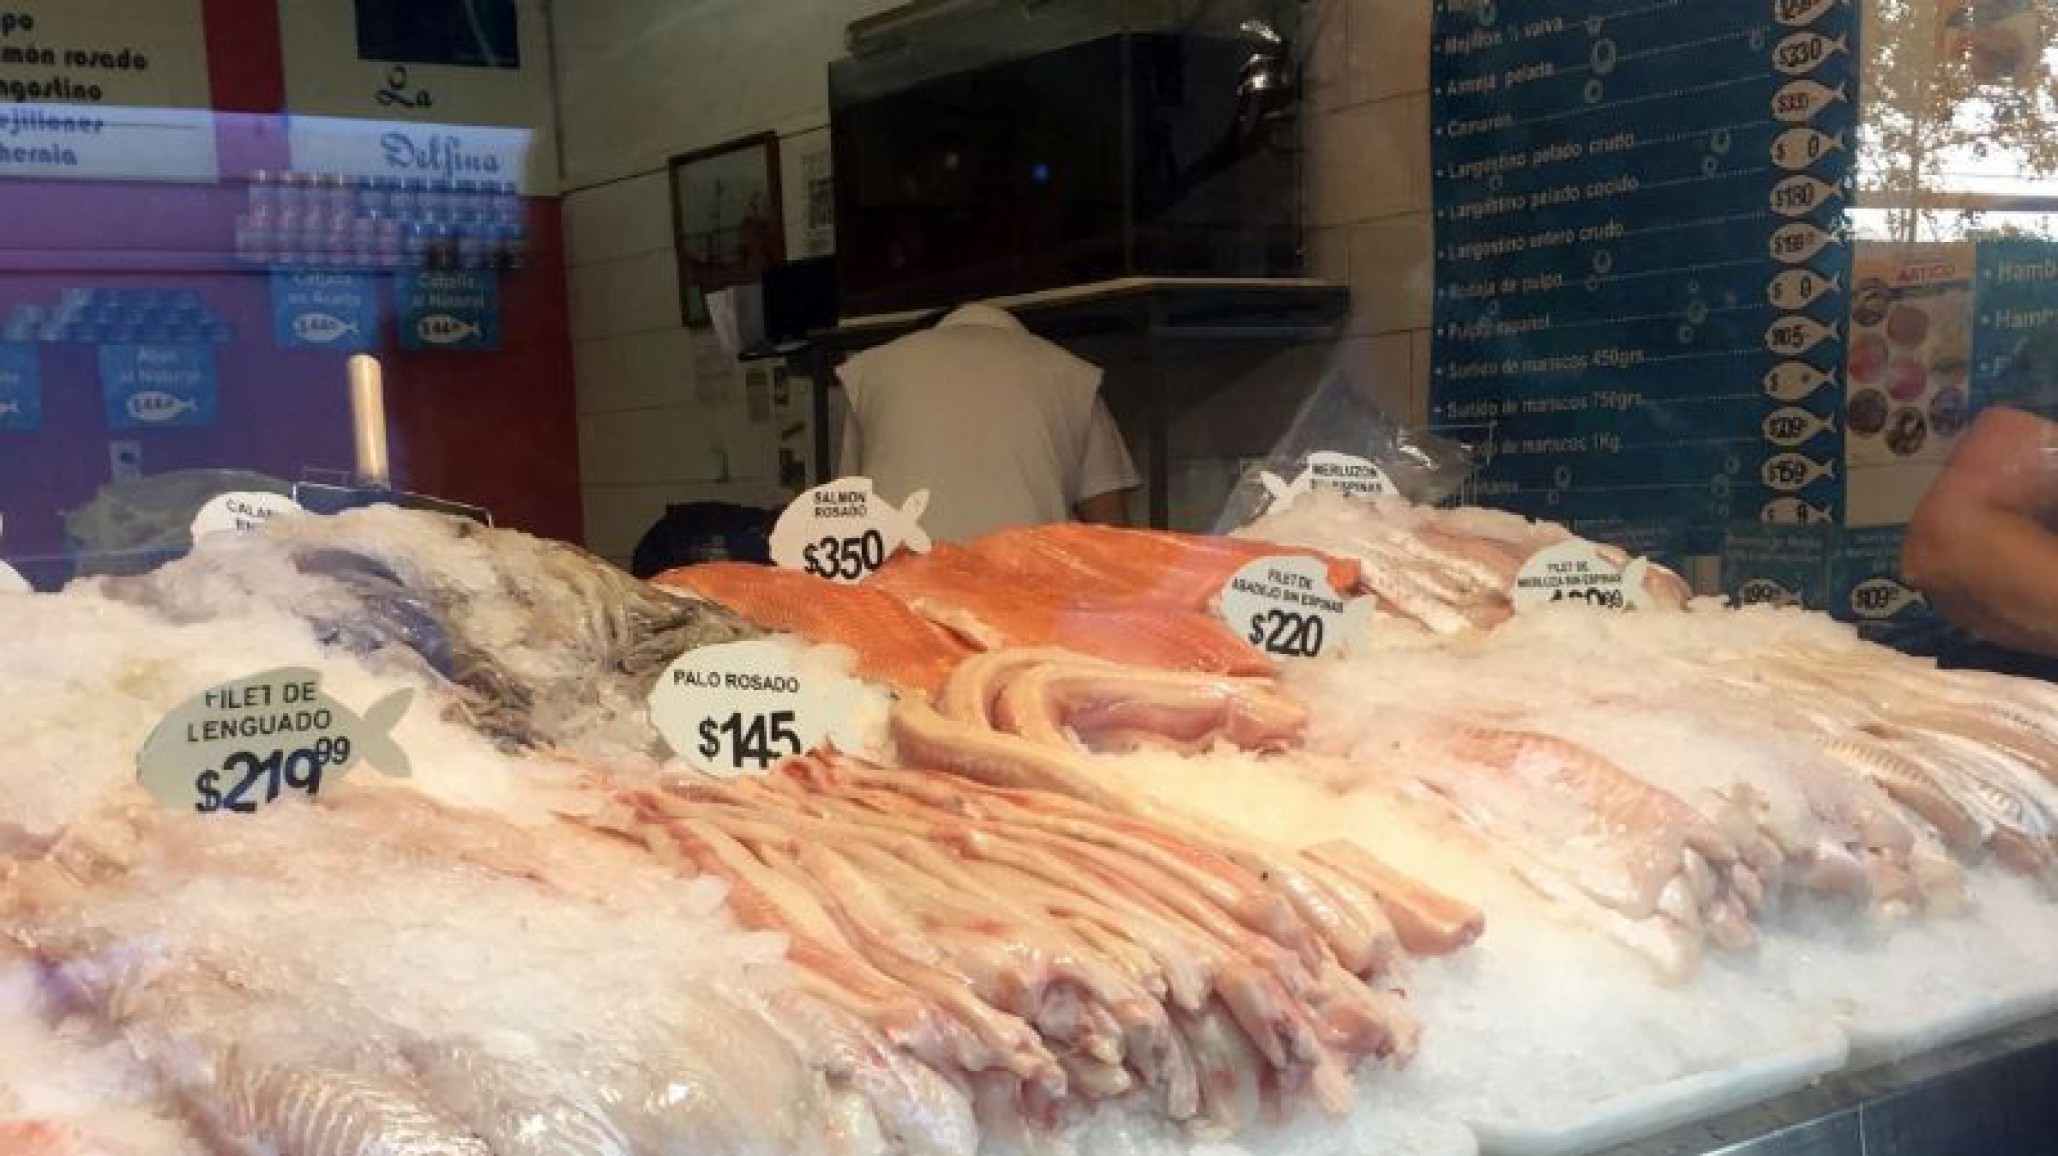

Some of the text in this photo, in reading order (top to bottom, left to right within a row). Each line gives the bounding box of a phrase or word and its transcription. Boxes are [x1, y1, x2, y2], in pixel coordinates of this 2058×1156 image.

[64, 48, 148, 71] rosado
[380, 132, 500, 177] Delfina
[1533, 144, 1583, 167] pelado
[815, 505, 868, 518] ROSADO
[802, 528, 884, 580] $350
[1248, 608, 1324, 658] $220
[205, 681, 317, 709] FILET DE
[673, 668, 801, 694] PALO ROSADO
[187, 708, 333, 742] LENGUADO
[698, 709, 803, 770] $145
